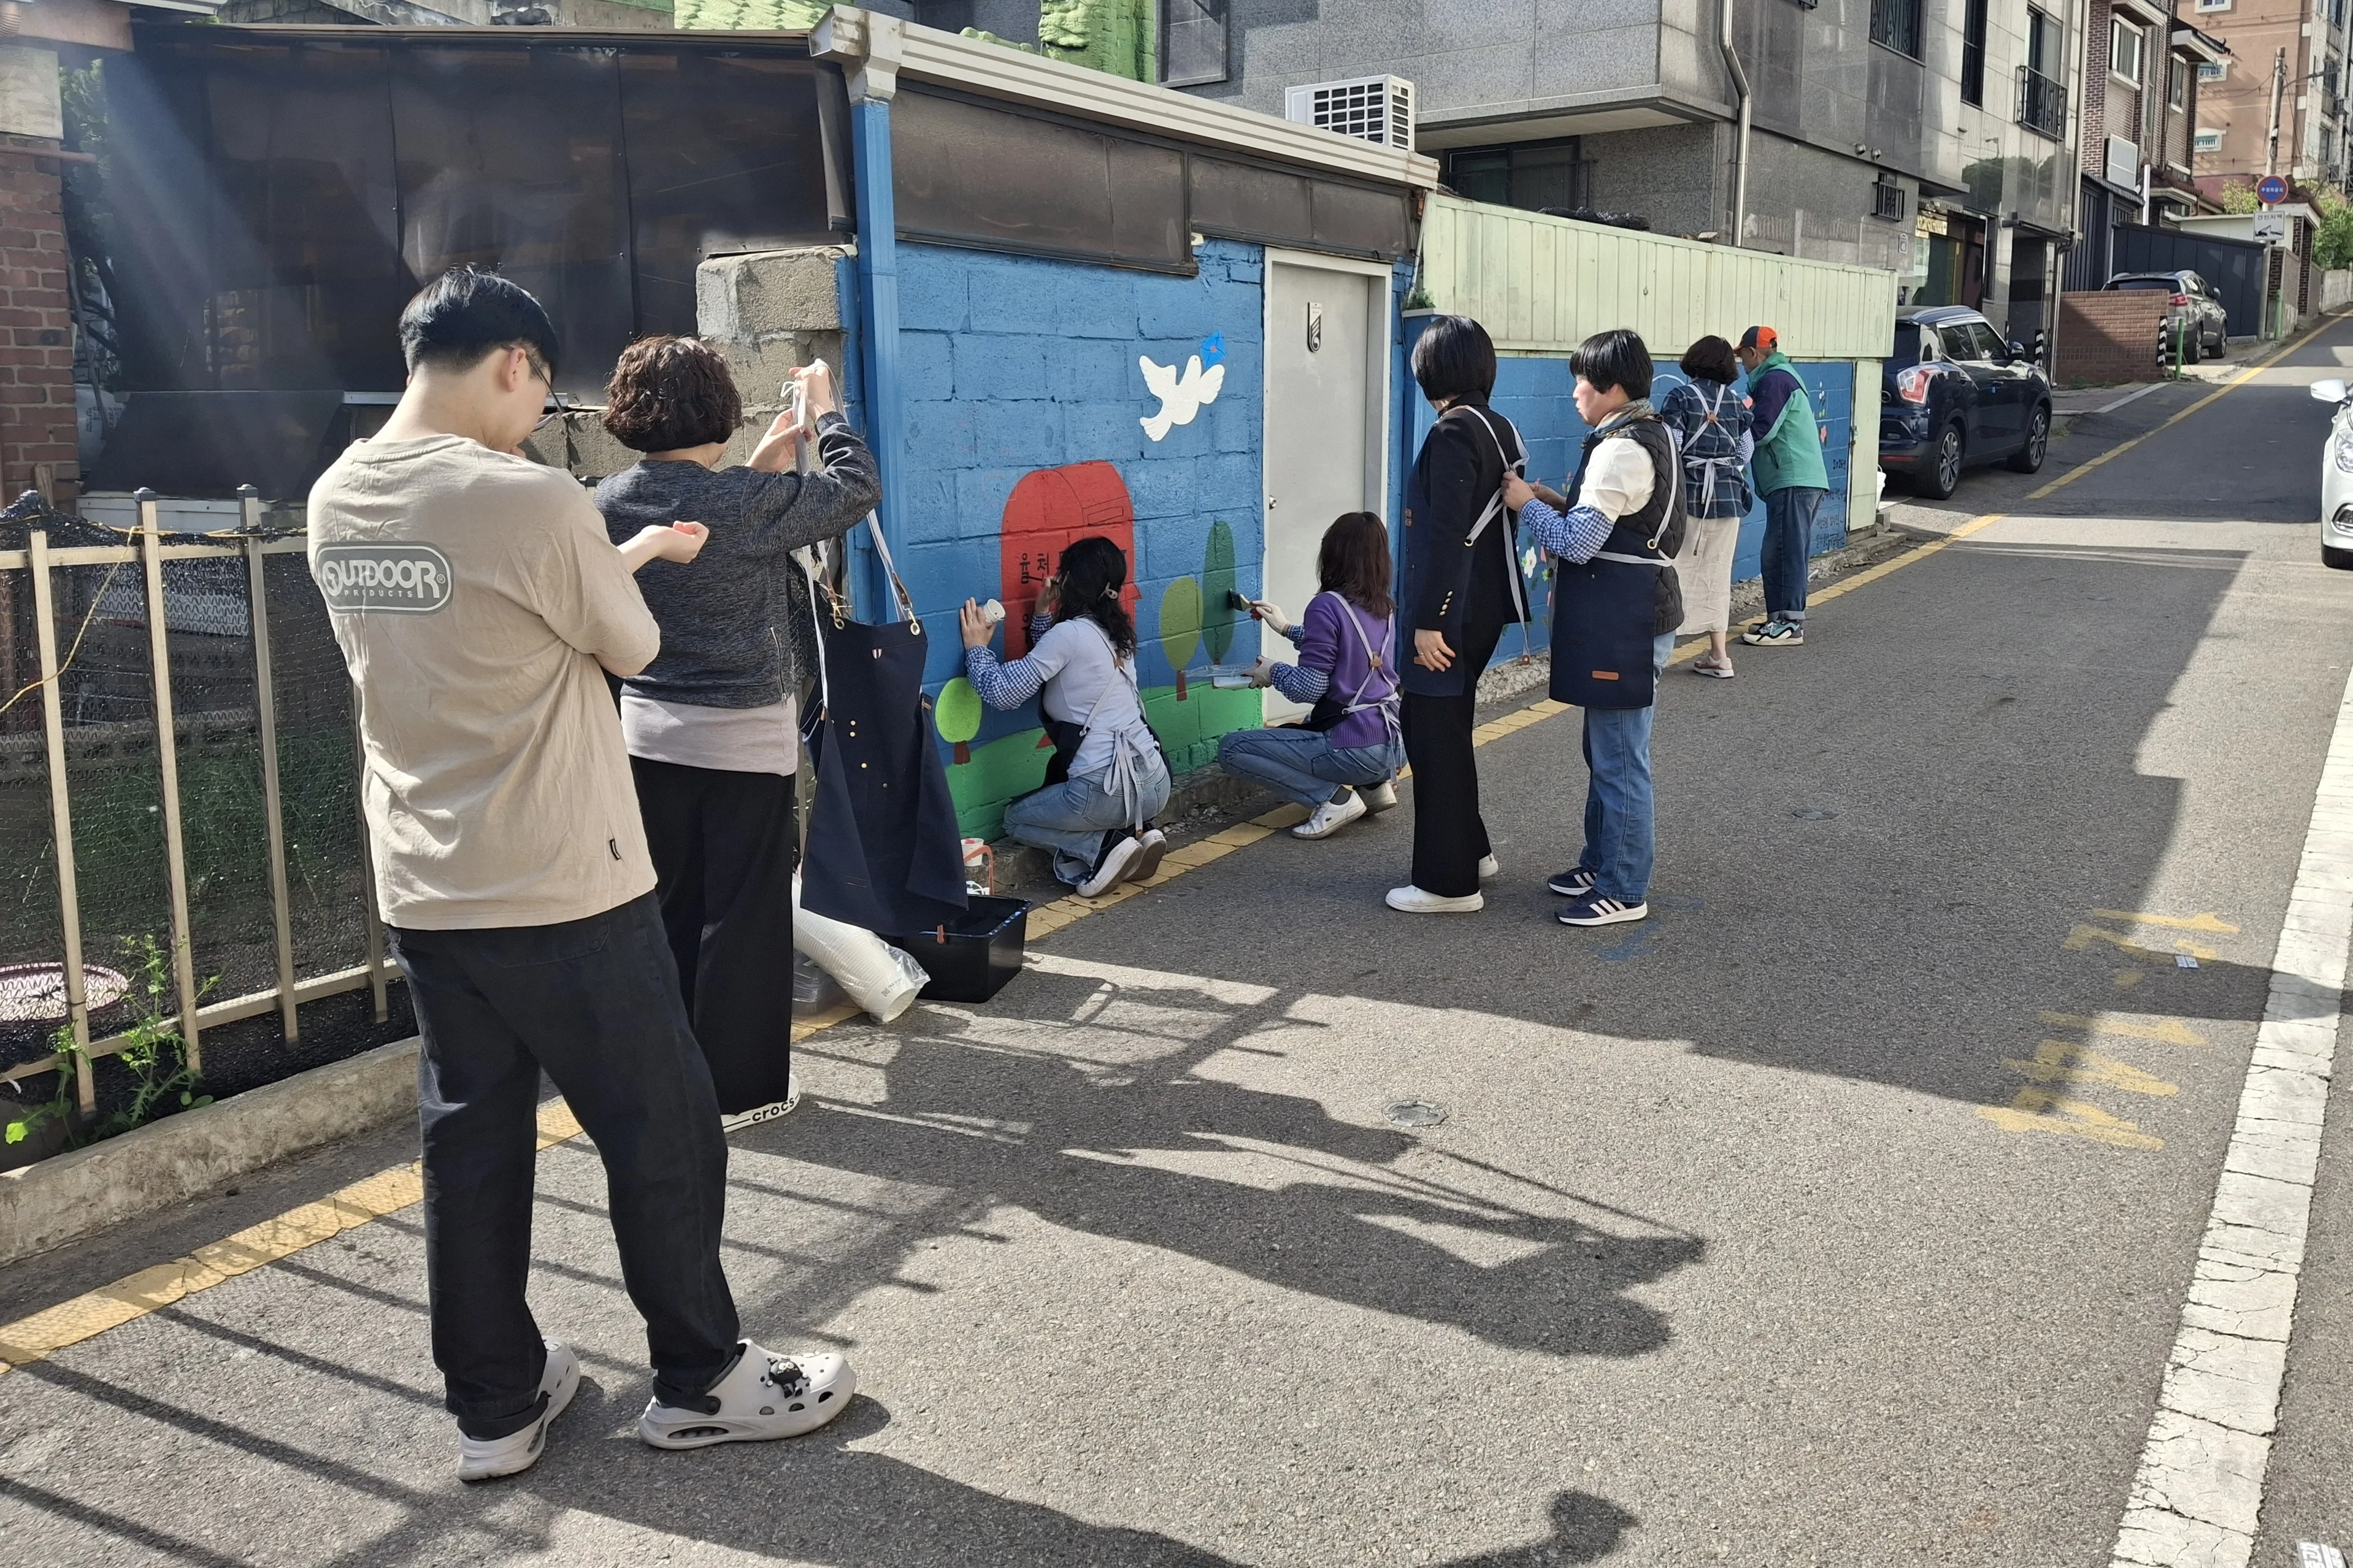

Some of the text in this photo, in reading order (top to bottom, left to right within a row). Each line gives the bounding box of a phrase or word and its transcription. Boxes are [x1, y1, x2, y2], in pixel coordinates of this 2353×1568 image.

[322, 559, 440, 599] OUTDOOR
[344, 589, 413, 599] PRODUCTS
[752, 1097, 795, 1122] crocs
